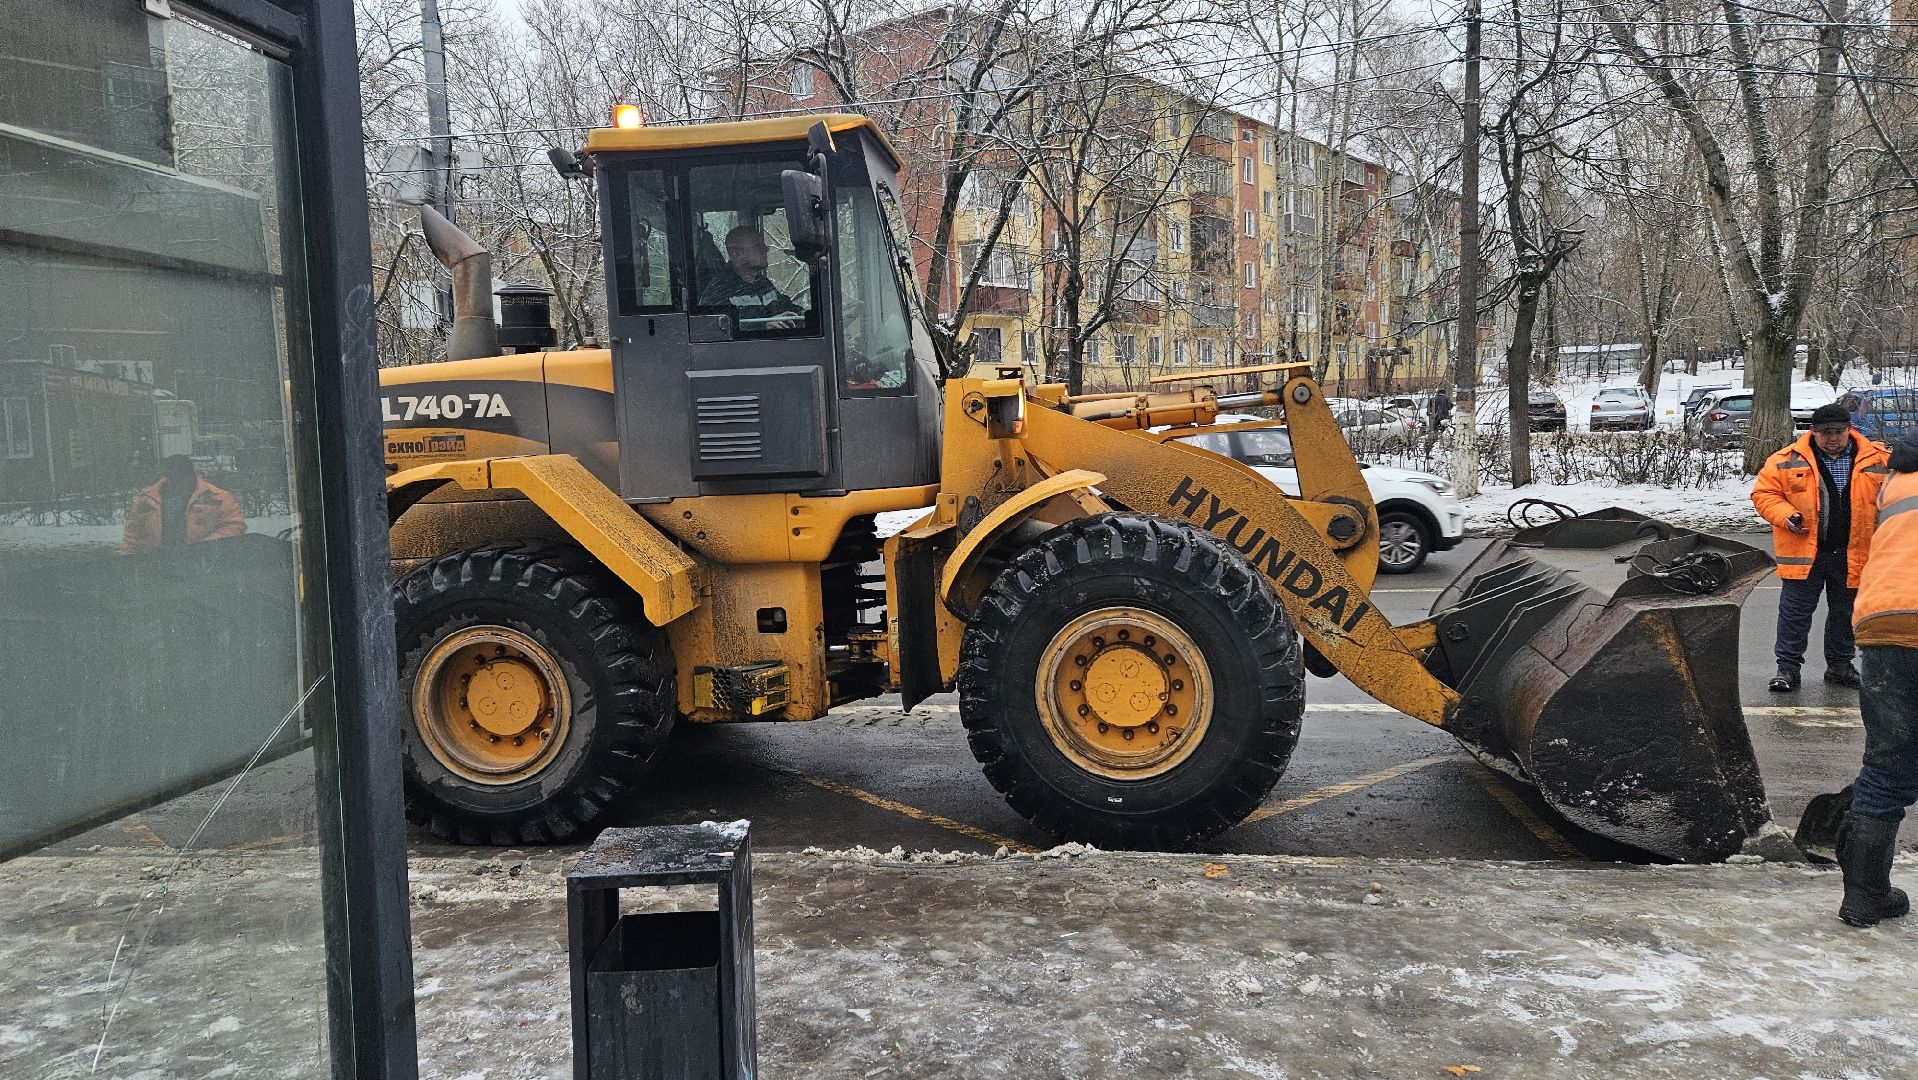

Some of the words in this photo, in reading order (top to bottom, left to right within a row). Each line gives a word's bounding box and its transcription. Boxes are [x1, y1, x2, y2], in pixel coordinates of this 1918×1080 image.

[381, 393, 511, 421] L740-7A
[384, 435, 465, 454] ехноГрэйд
[1167, 475, 1370, 633] HYUNDAI
